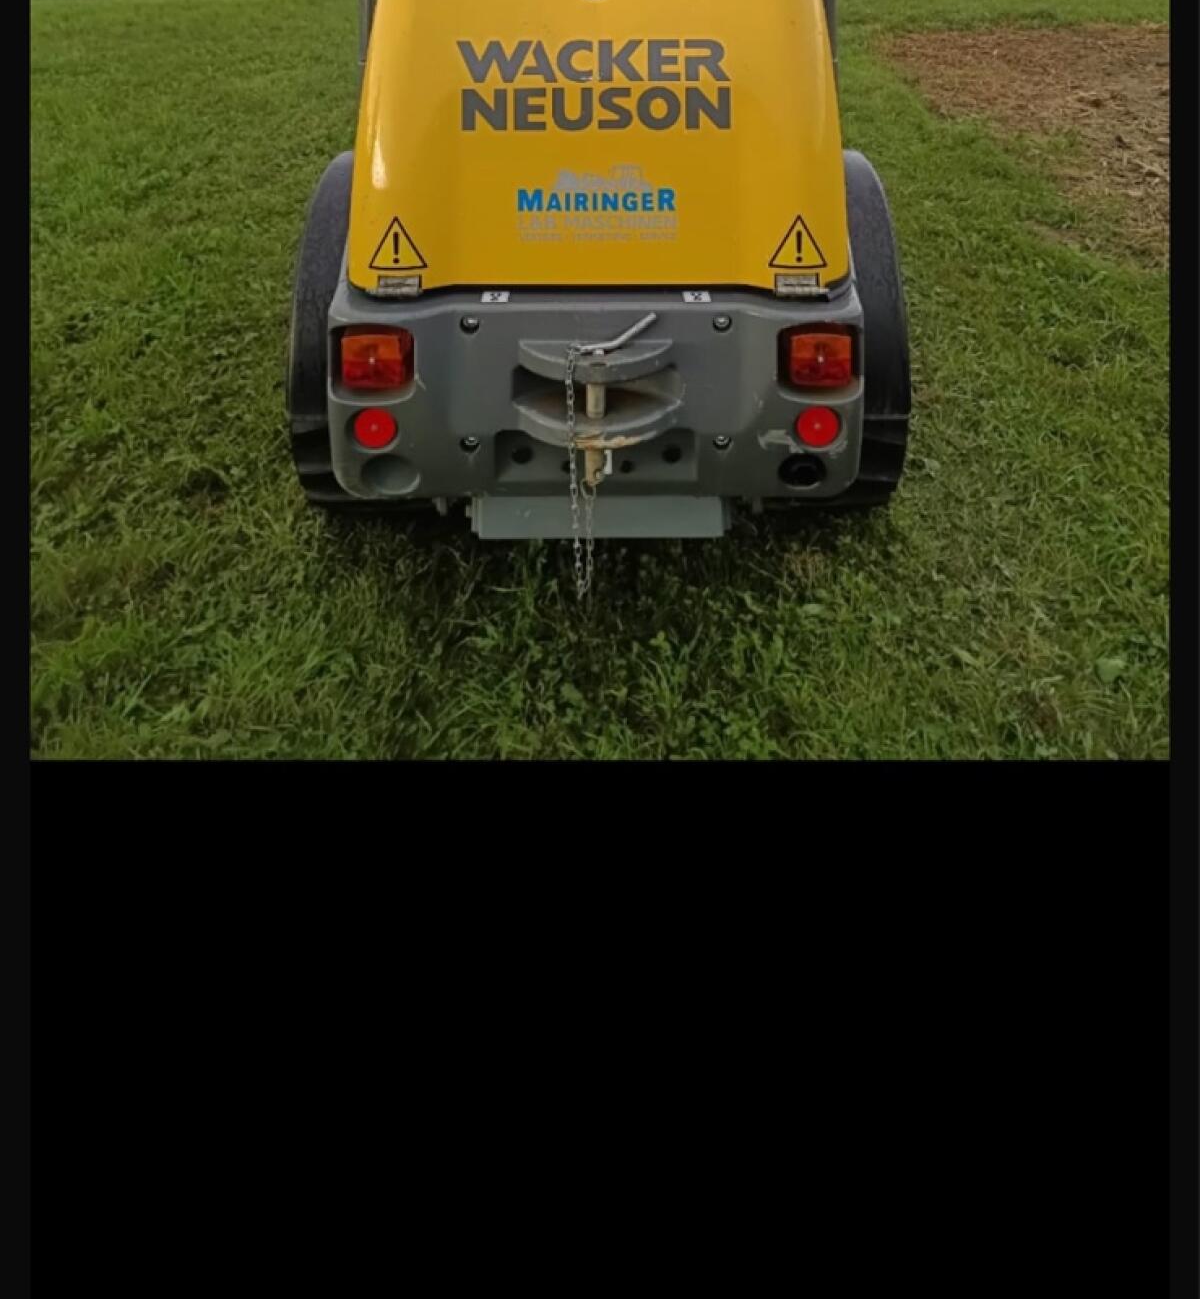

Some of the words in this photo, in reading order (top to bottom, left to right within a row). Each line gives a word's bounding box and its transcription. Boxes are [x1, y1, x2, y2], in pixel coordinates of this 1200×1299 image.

[457, 39, 731, 83] WACKER
[461, 87, 731, 131] NEUSON
[517, 188, 676, 212] MAIRINGER
